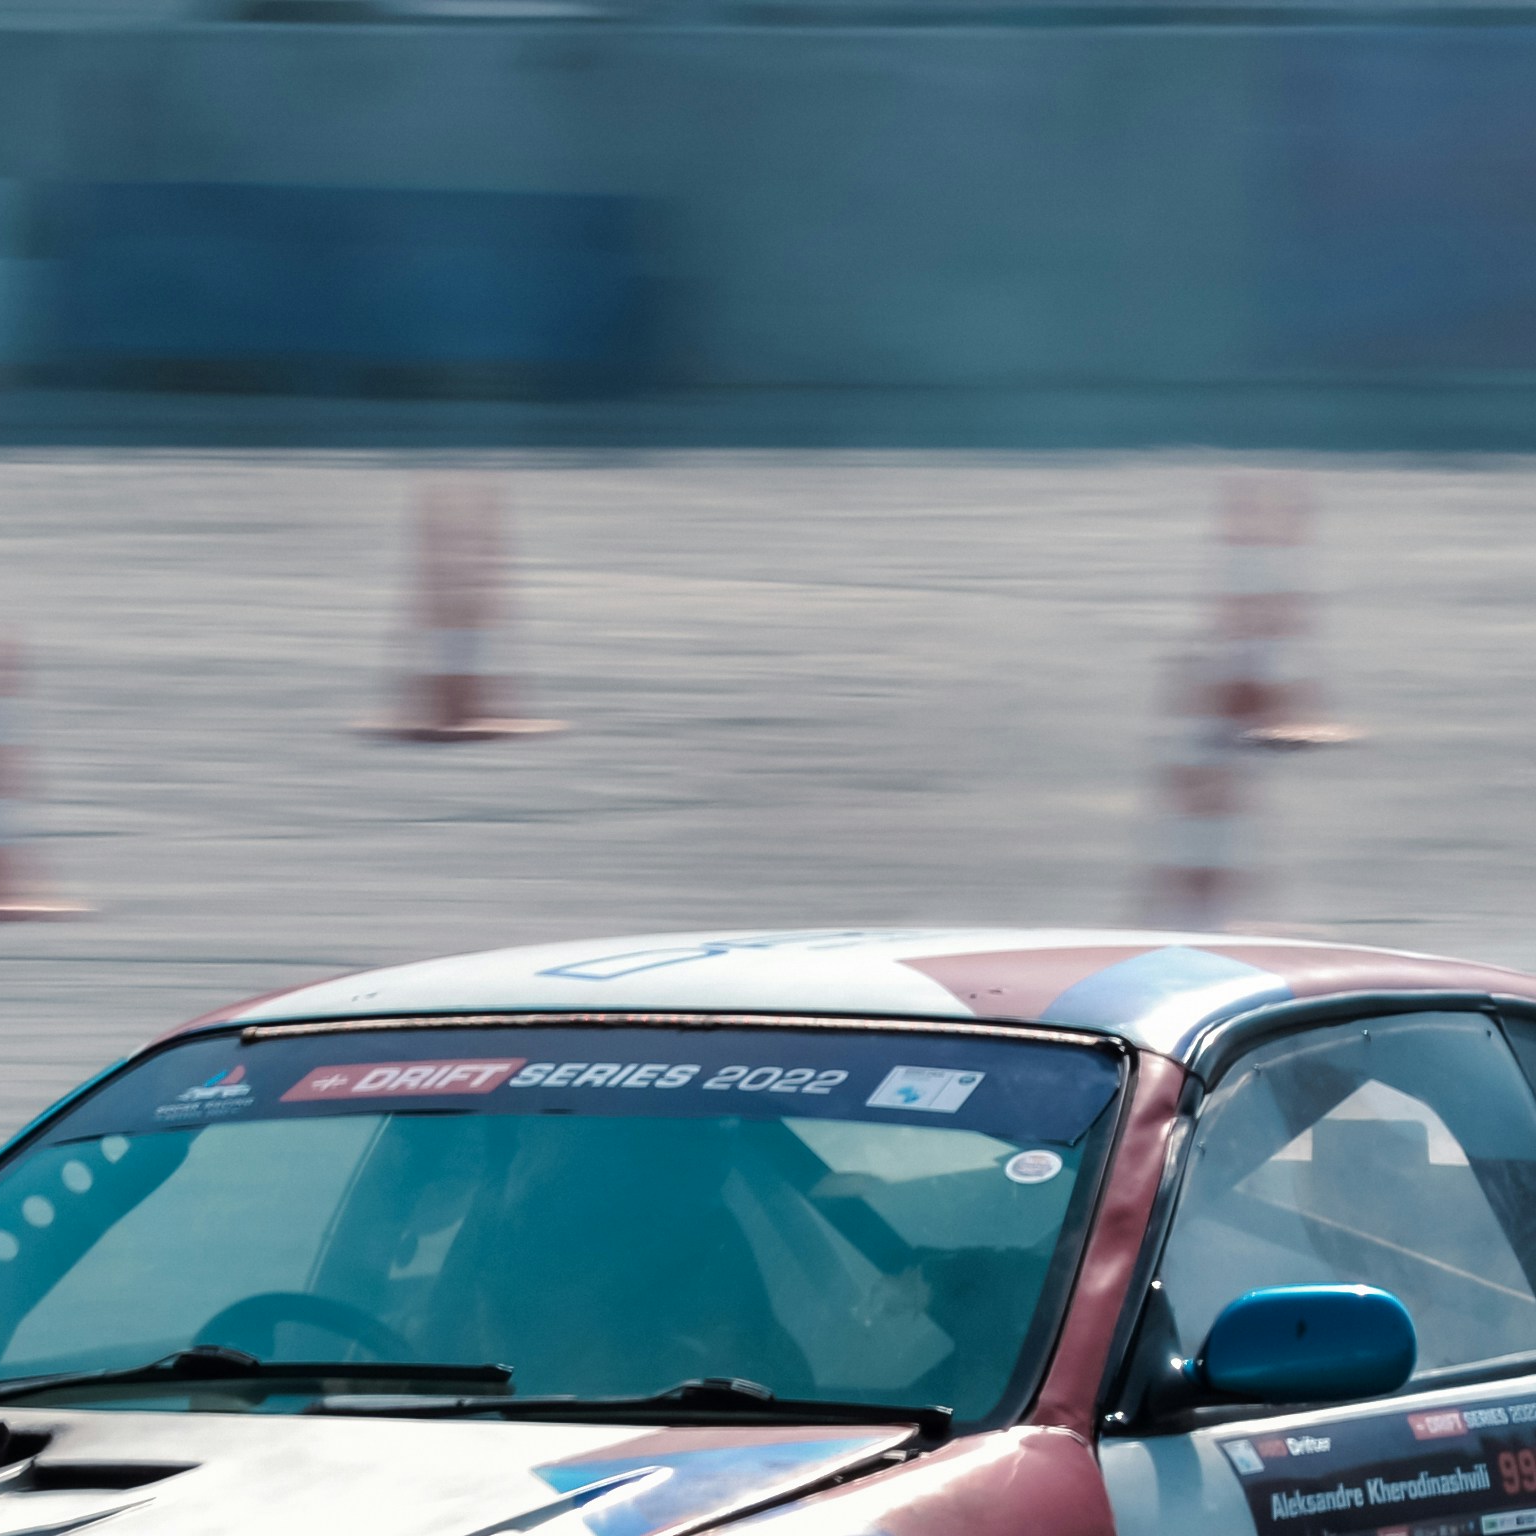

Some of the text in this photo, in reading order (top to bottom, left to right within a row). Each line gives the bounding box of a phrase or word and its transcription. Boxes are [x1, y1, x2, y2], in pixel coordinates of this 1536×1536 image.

[351, 1062, 850, 1094] DRIFT SERIES 2022
[1463, 1407, 1509, 1429] SERIES
[1272, 1462, 1491, 1521] Aleksandre Kherodinashvili
